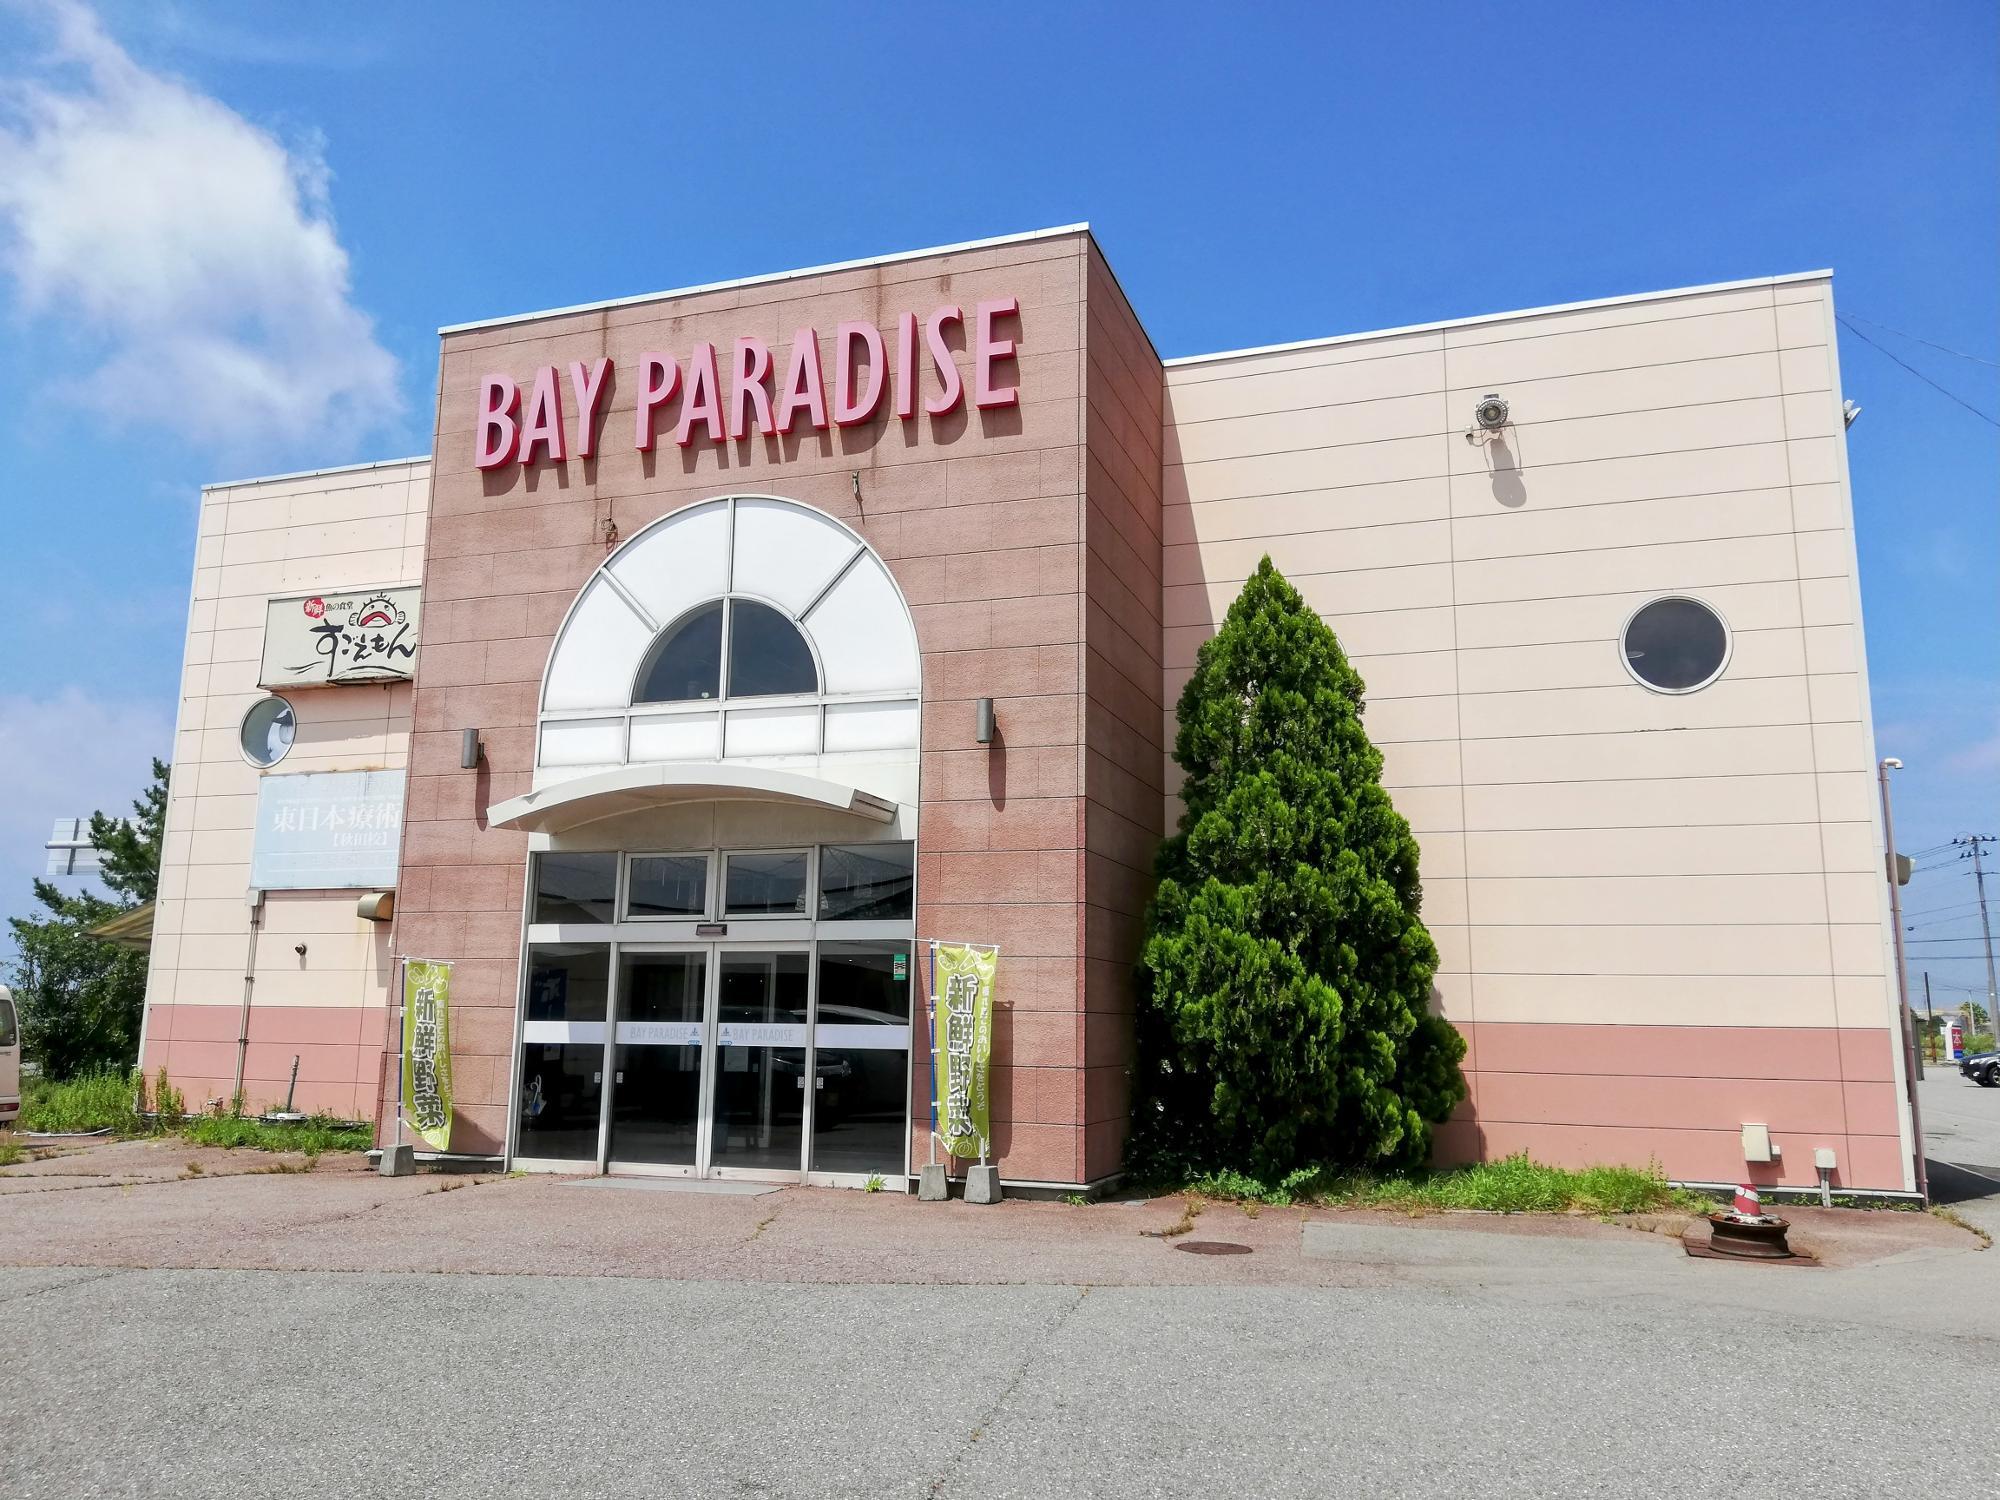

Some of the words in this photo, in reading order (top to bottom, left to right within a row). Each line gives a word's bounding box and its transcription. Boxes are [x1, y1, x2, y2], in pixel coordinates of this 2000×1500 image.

[475, 357, 614, 471] BAY
[634, 297, 1020, 452] PARADISE
[413, 988, 446, 1129] 新鮮野菜
[629, 1026, 646, 1041] BAY
[648, 1025, 689, 1041] PARADISE
[732, 1028, 750, 1042] BAY
[752, 1028, 793, 1042] PARADISE
[945, 973, 980, 1137] 新鮮野菜
